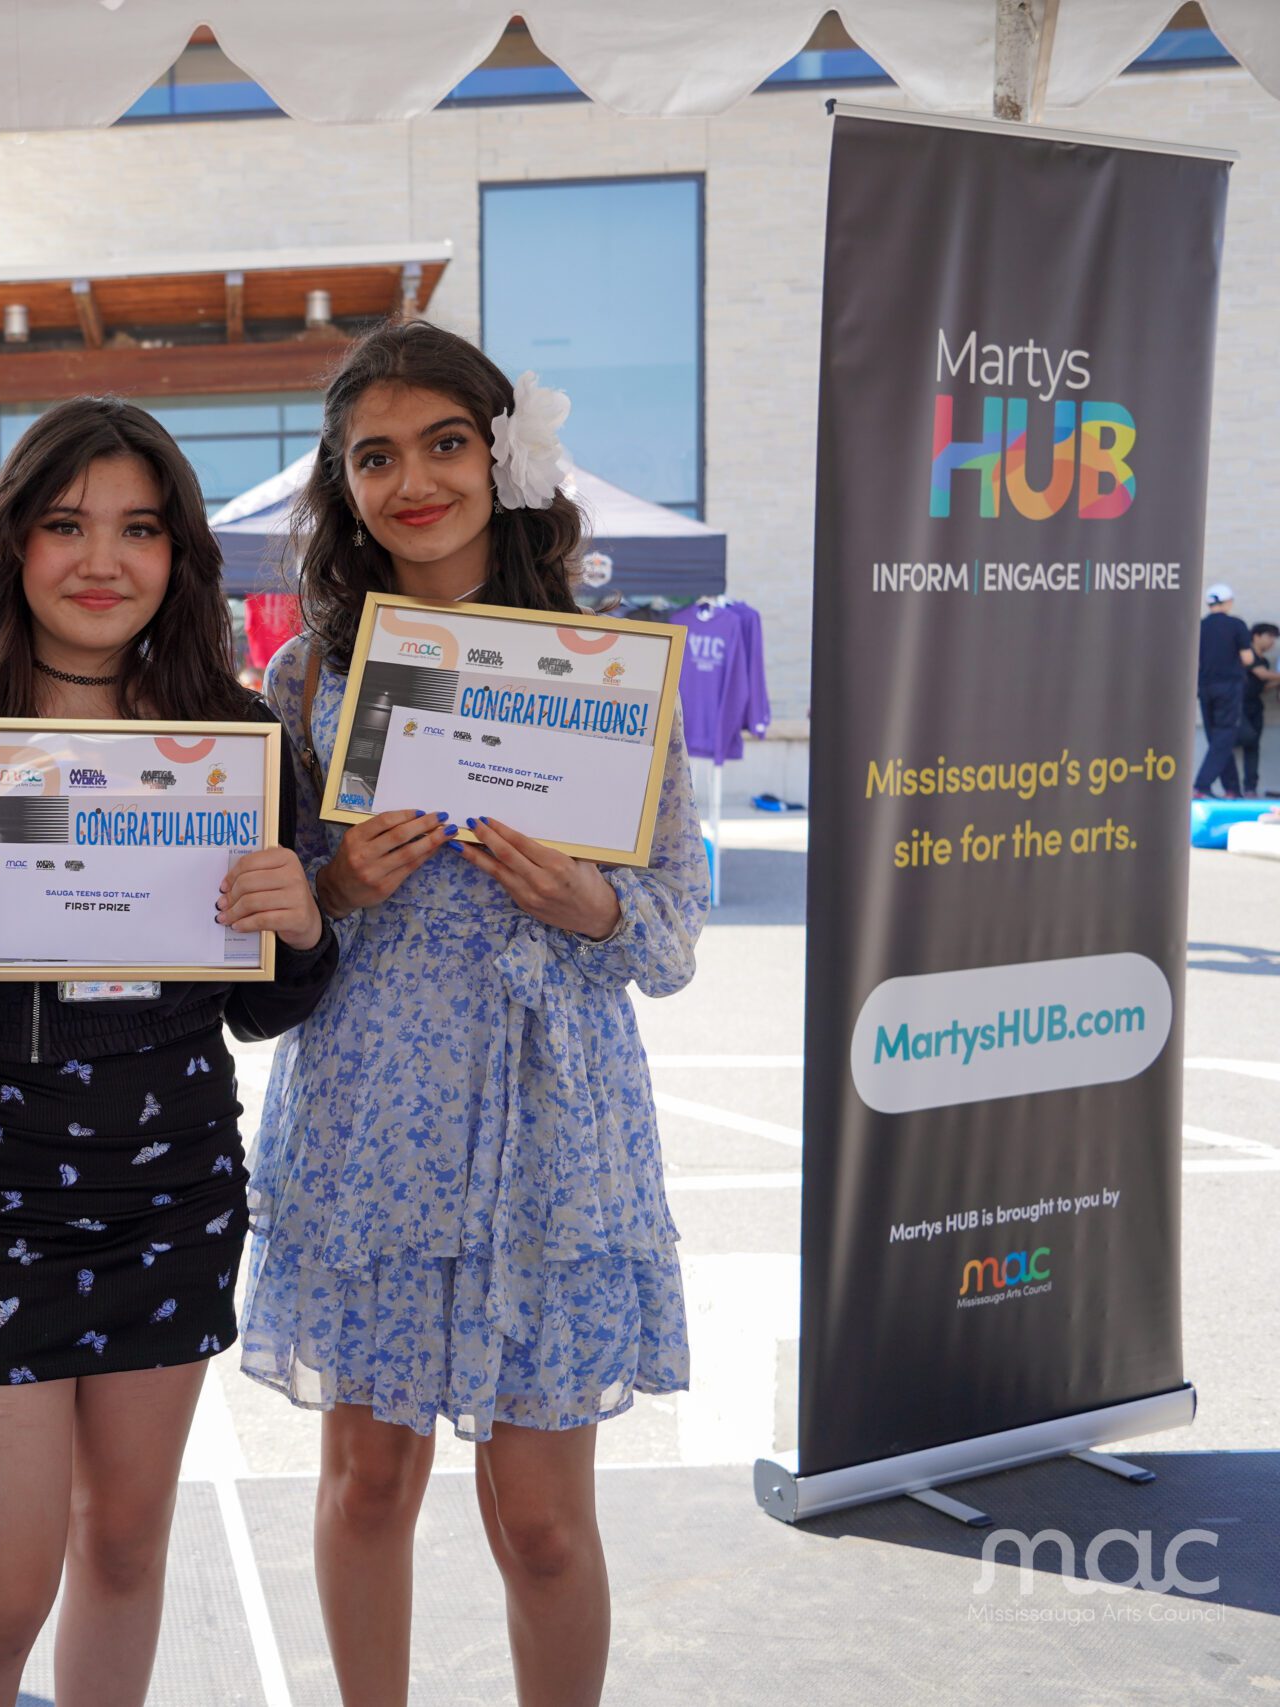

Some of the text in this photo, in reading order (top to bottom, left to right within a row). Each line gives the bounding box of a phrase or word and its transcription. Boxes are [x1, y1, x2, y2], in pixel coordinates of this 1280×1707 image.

[936, 327, 1091, 402] Martys
[928, 394, 1137, 521] HUB
[871, 562, 1181, 592] INFORM ENGAGE INSPIRE
[400, 641, 442, 657] mac
[460, 685, 649, 737] CONGRATULATIONS!
[69, 768, 105, 779] METAL
[458, 759, 564, 782] SAUGA TEENS GOT TALENT
[467, 772, 550, 794] SECOND PRIZE
[866, 747, 1177, 799] Mississauga's go-to
[75, 809, 259, 847] CONGRATULATIONS!
[893, 818, 1138, 869] site for the arts.
[46, 889, 74, 897] SAUGA
[65, 902, 131, 912] FIRST PRIZE
[873, 1002, 1147, 1066] MartysHUB.com
[889, 1187, 1121, 1244] Martys HUB is brought to you by
[959, 1246, 1052, 1296] mac
[956, 1281, 1053, 1310] Mississauga Arts Council
